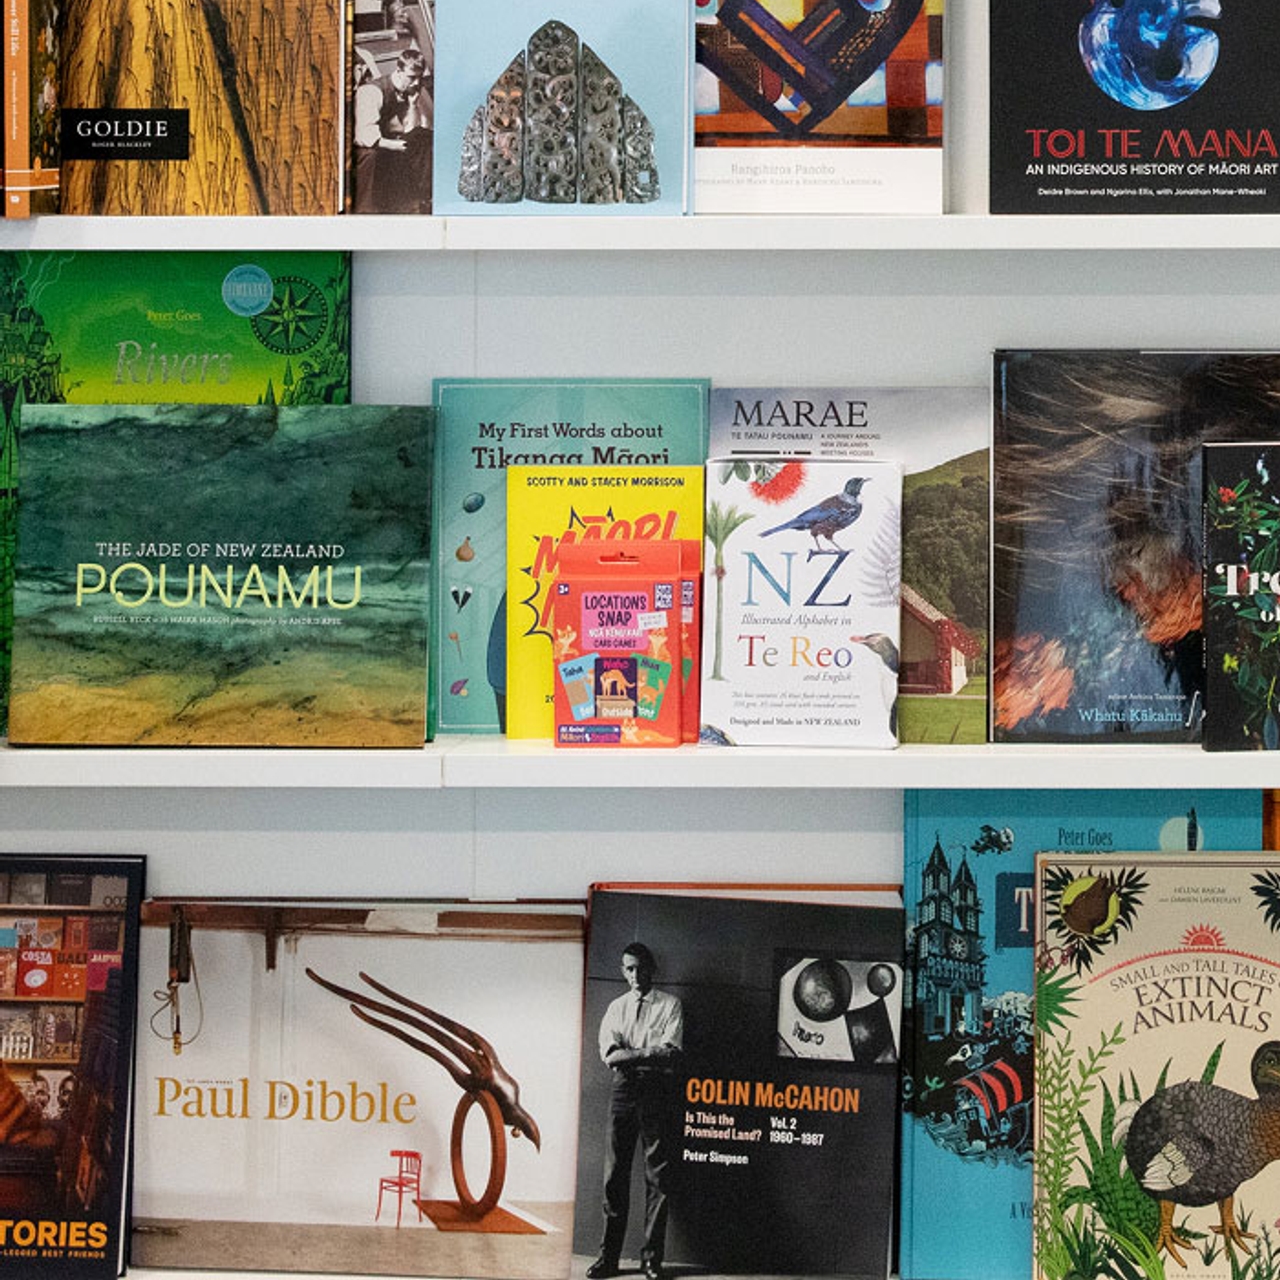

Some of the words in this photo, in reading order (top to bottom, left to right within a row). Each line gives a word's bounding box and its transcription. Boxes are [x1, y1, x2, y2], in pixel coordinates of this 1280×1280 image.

[77, 120, 169, 138] GOLDIE
[1025, 129, 1085, 158] TOI
[1097, 129, 1142, 158] TE
[1153, 129, 1279, 158] MANA
[1025, 164, 1044, 175] AN
[1047, 164, 1127, 175] INDIGENOUS
[1130, 164, 1183, 175] HISTORY
[1187, 164, 1205, 175] OF
[1208, 161, 1250, 175] MĀORI
[1253, 164, 1278, 175] ART
[113, 340, 234, 385] Rivers
[732, 400, 869, 427] MARAE
[478, 422, 506, 441] My
[509, 422, 550, 438] First
[552, 423, 605, 438] Words
[610, 423, 663, 438] about
[526, 477, 564, 486] SCOTTY
[567, 477, 588, 486] AND
[590, 477, 628, 487] STACEY
[631, 477, 685, 487] MORRISON
[96, 542, 131, 556] THE
[136, 542, 182, 557] JADE
[186, 543, 209, 557] OF
[215, 543, 257, 557] NEW
[261, 544, 345, 559] ZEALAND
[76, 562, 362, 609] POUNAMU
[741, 549, 854, 606] NZ
[584, 595, 647, 611] LOCATIONS
[598, 611, 632, 627] SNAP
[741, 614, 790, 626] Illustrated
[794, 614, 837, 628] Alphabet
[737, 634, 778, 667] Te
[790, 636, 853, 668] Reo
[822, 672, 851, 683] English
[1078, 708, 1126, 721] Whatu
[1058, 827, 1085, 846] Peter
[1088, 827, 1113, 846] Goes
[1110, 965, 1160, 992] SMALL
[1163, 962, 1190, 974] AND
[1192, 959, 1228, 972] TALL
[1232, 962, 1277, 985] TALES
[1132, 976, 1272, 1007] EXTINCT
[1132, 1000, 1272, 1034] ANIMALS
[154, 1077, 250, 1119] Paul
[264, 1079, 417, 1124] Dibble
[686, 1077, 750, 1106] COLIN
[754, 1082, 860, 1113] McCAHON
[685, 1111, 694, 1123] Is
[696, 1112, 716, 1124] This
[718, 1113, 735, 1126] the
[769, 1117, 787, 1129] Vol.
[789, 1118, 797, 1129] 2
[684, 1125, 730, 1140] Promised
[731, 1128, 762, 1141] Land?
[683, 1149, 708, 1162] Peter
[709, 1150, 749, 1166] Simpson
